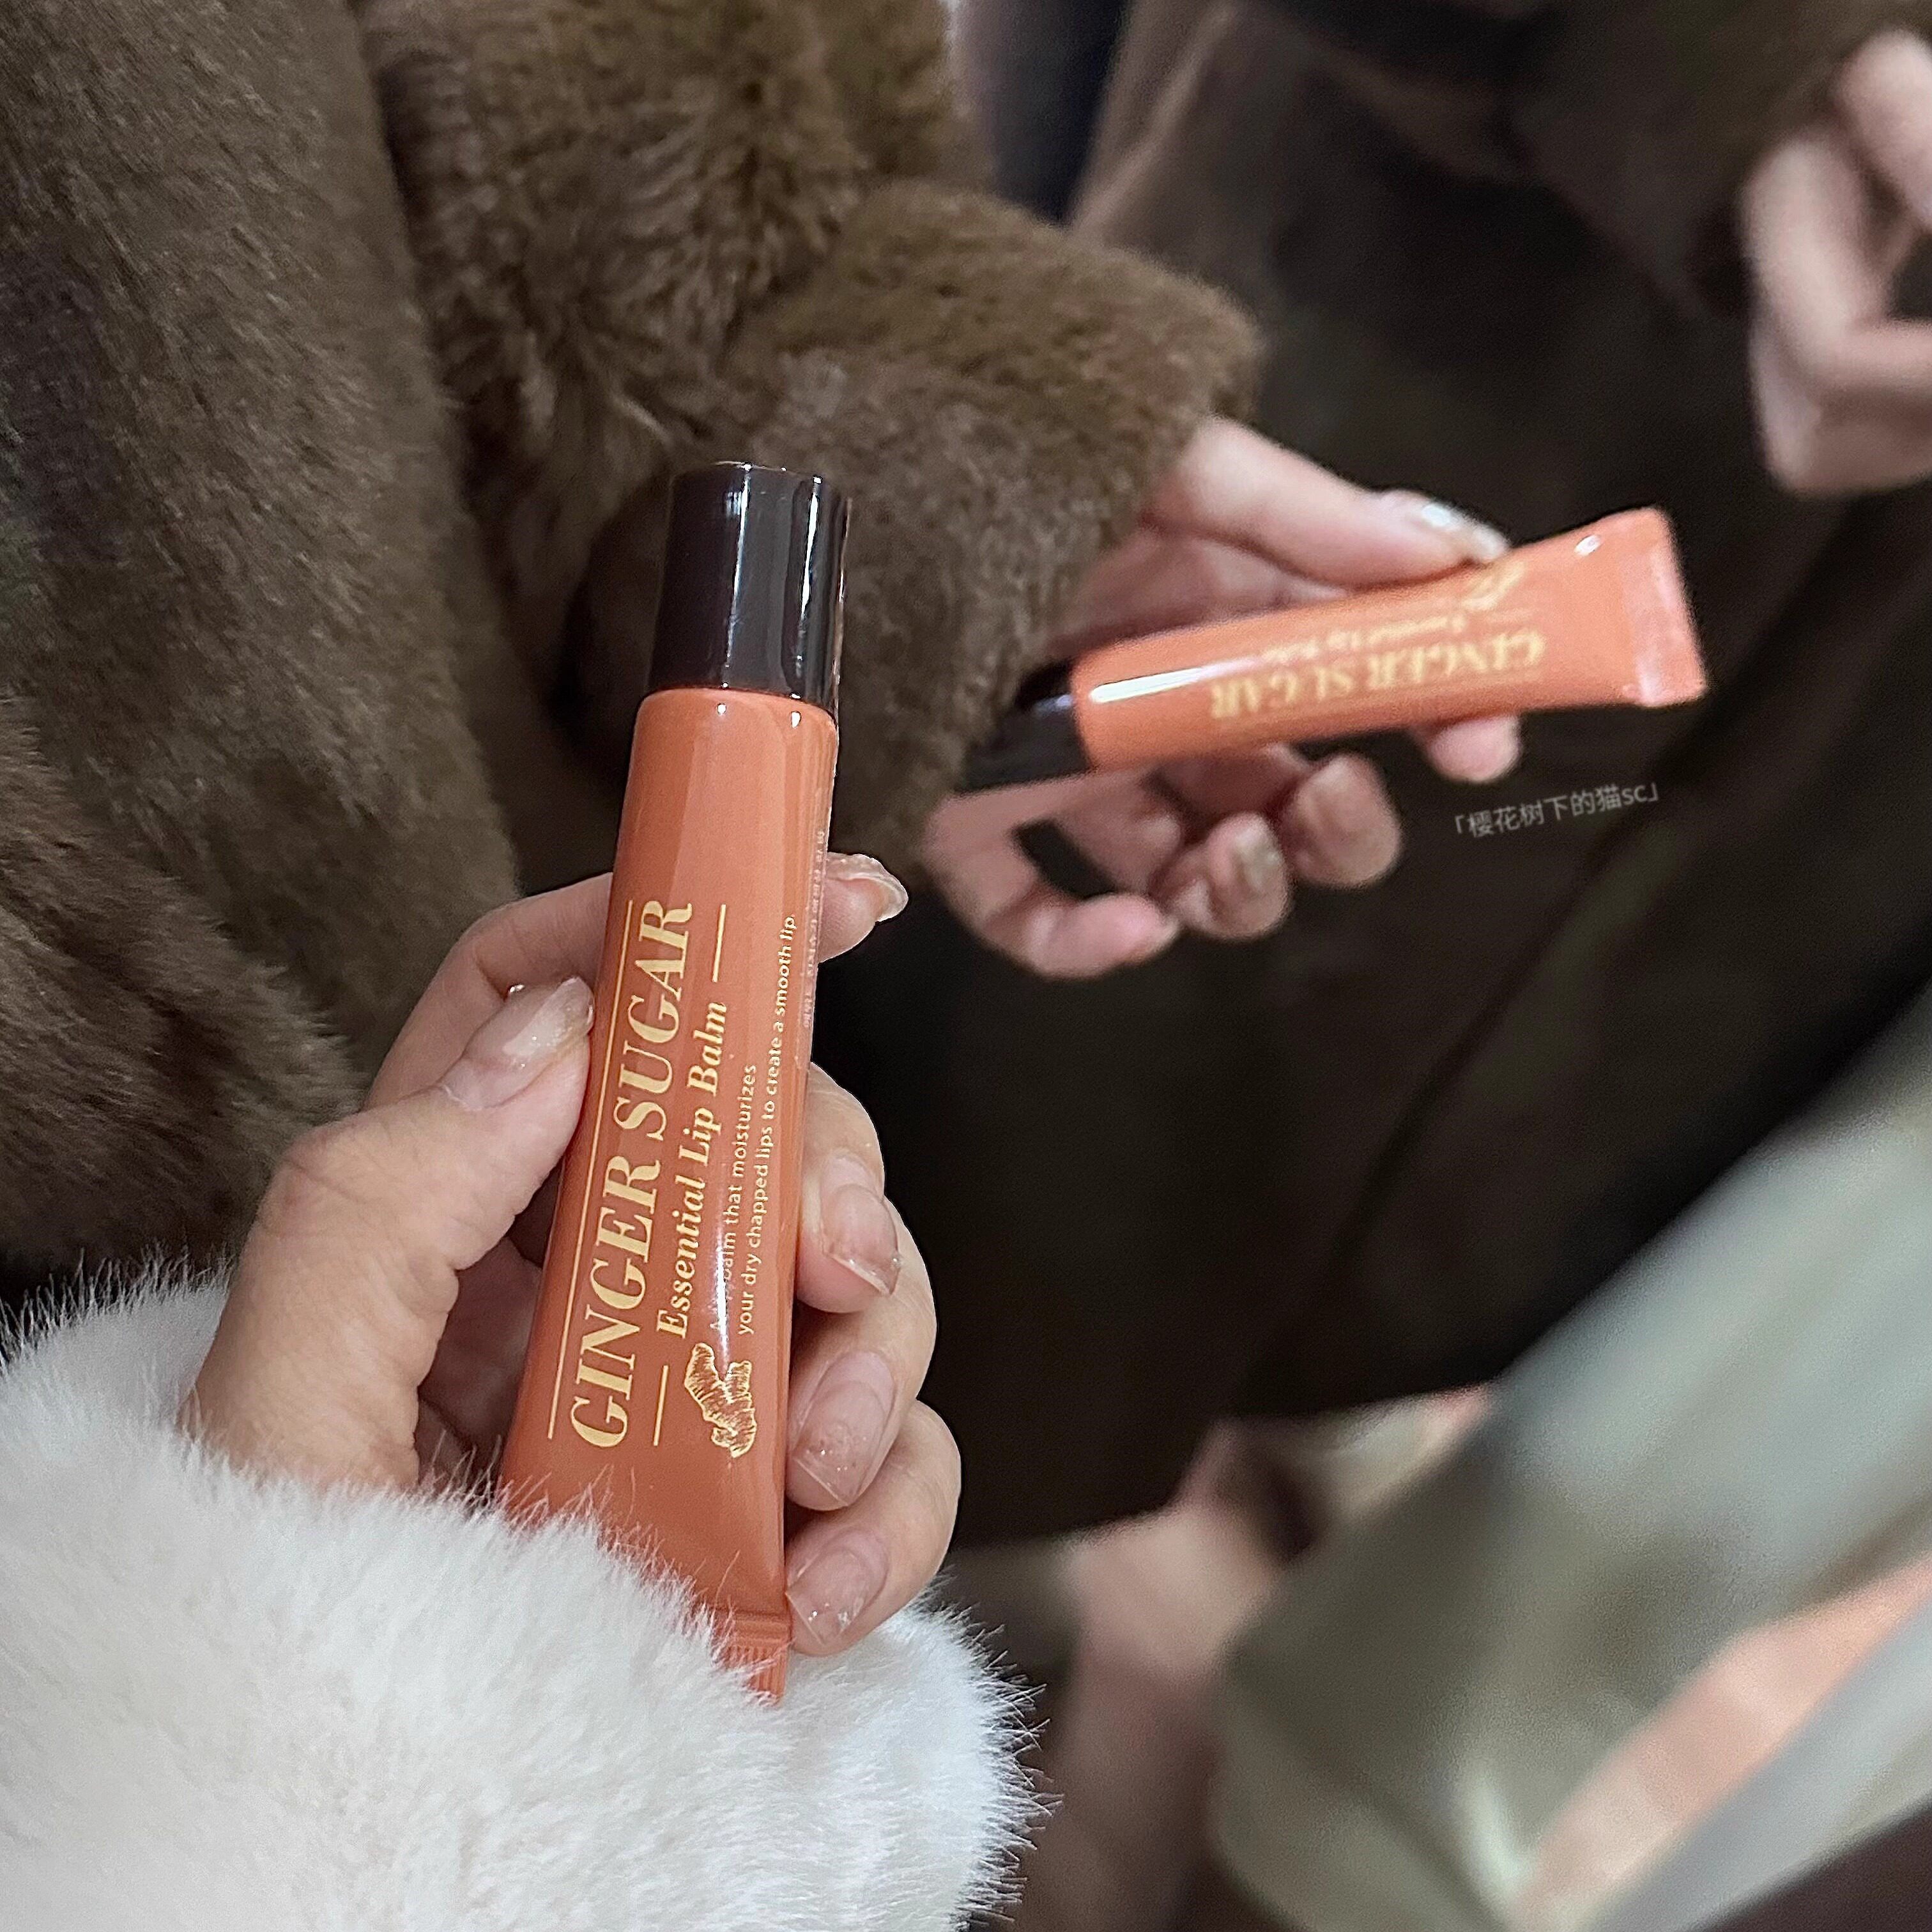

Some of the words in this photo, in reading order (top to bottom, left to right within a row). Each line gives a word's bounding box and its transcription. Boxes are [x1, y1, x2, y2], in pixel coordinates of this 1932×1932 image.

[775, 945, 792, 1017] smooth
[613, 900, 693, 1142] SUGAR
[686, 1002, 727, 1097] Balm
[775, 1021, 785, 1034] a
[766, 1036, 783, 1096] create
[678, 1107, 723, 1167] Lip
[732, 1064, 756, 1178] moisturizes
[762, 1100, 776, 1121] to
[755, 1125, 775, 1161] lips
[723, 1184, 743, 1226] that
[746, 1165, 770, 1248] chapped
[656, 1174, 707, 1339] Essential
[740, 1254, 763, 1286] dry
[570, 1155, 661, 1448] GINGER
[737, 1290, 755, 1336] your
